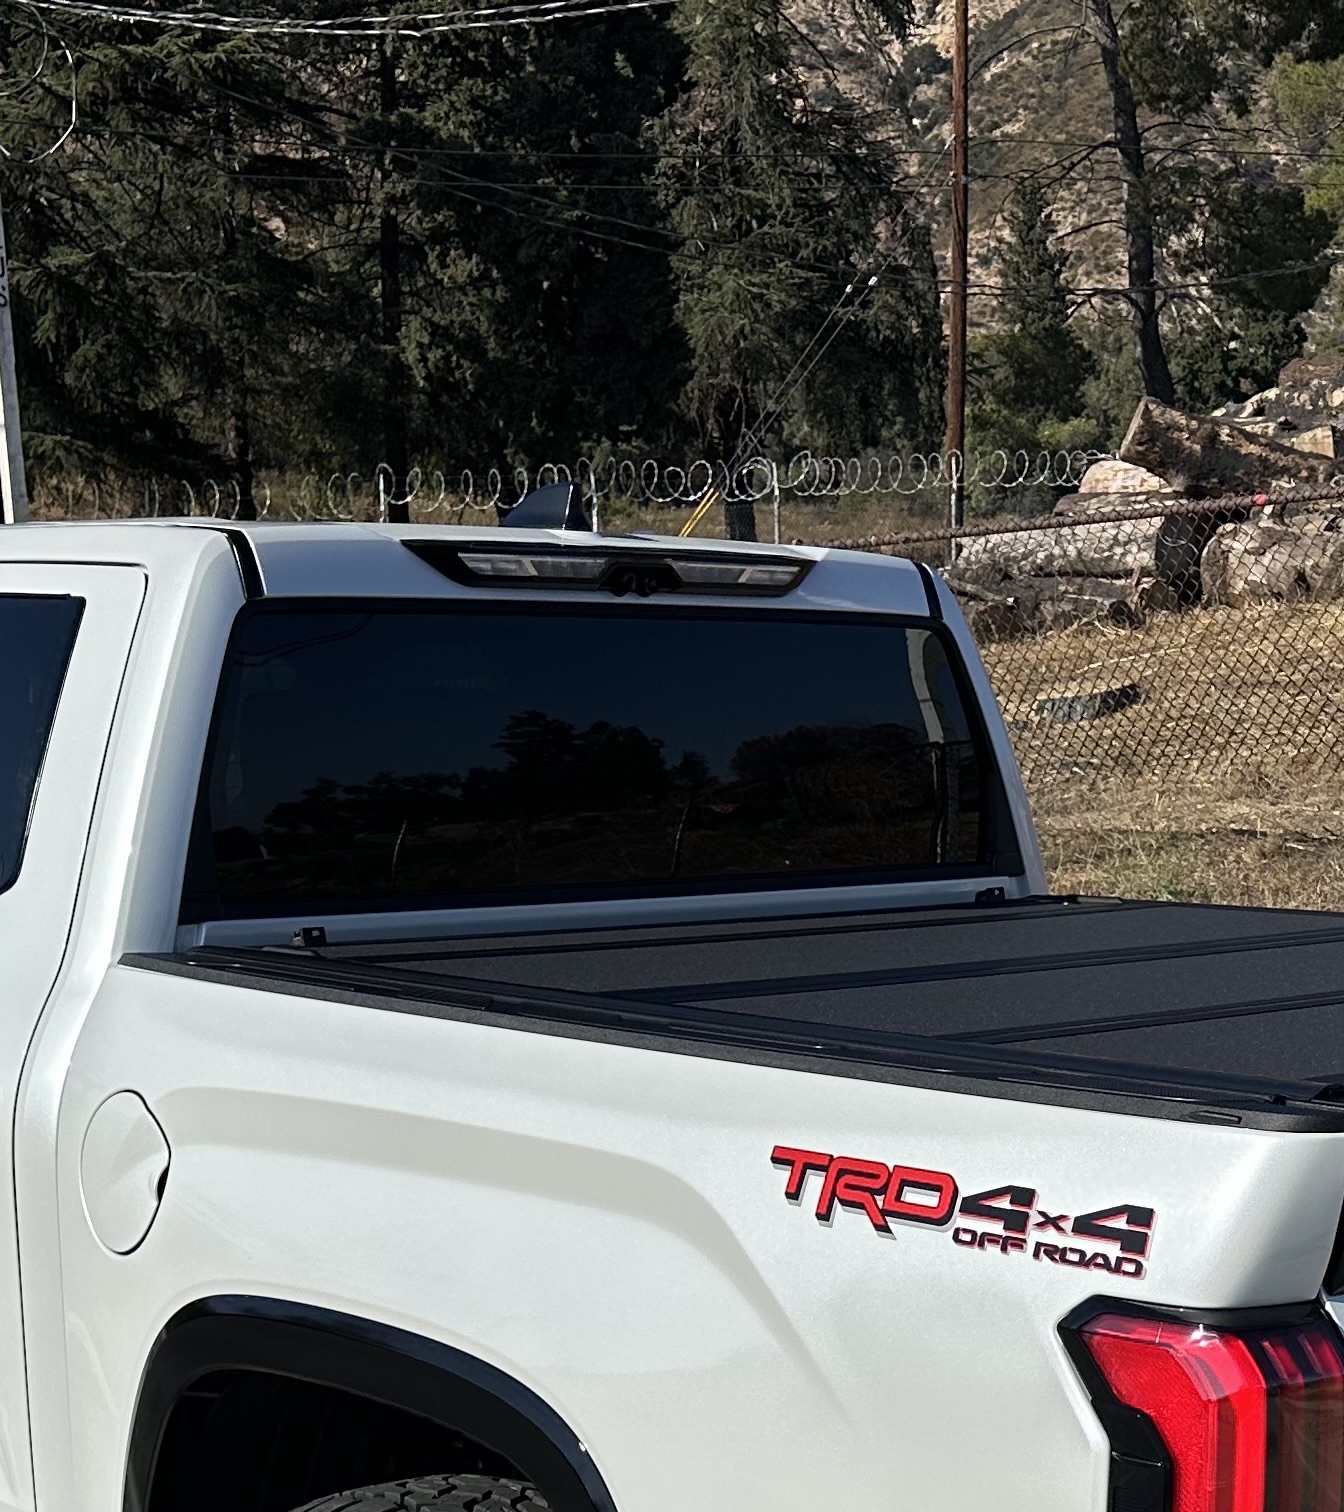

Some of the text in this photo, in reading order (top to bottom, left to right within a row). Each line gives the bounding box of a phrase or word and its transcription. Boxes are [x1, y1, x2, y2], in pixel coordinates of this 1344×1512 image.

[770, 1145, 960, 1238] TRD
[954, 1226, 1149, 1280] OFF ROAD
